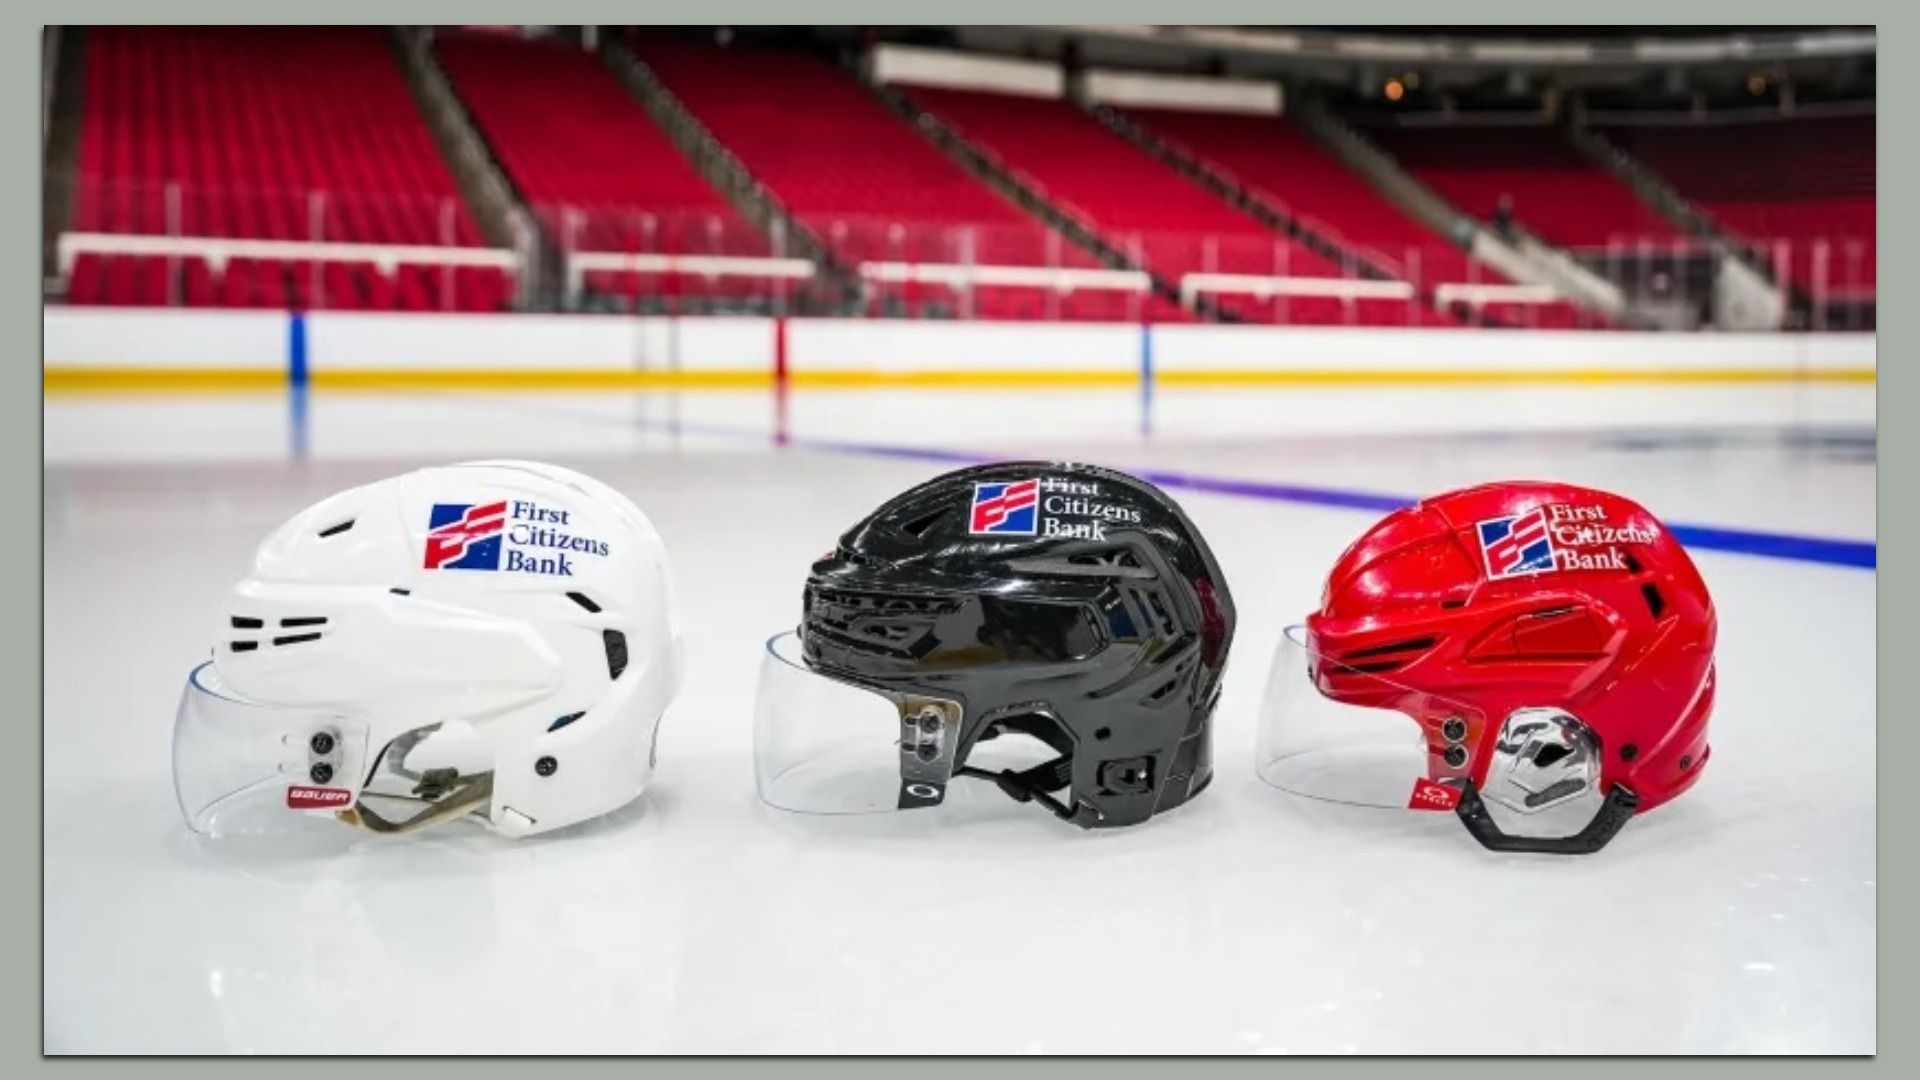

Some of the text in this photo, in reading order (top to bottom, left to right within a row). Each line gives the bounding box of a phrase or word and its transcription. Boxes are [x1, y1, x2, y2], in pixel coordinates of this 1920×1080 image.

[1043, 477, 1099, 496] First
[511, 500, 571, 525] First
[1044, 495, 1142, 523] Citizens
[1550, 503, 1608, 522] First
[508, 524, 609, 556] Citizens
[1043, 517, 1107, 541] Bank
[1556, 523, 1656, 546] Citizens
[505, 549, 573, 576] Bank
[1563, 547, 1629, 571] Bank
